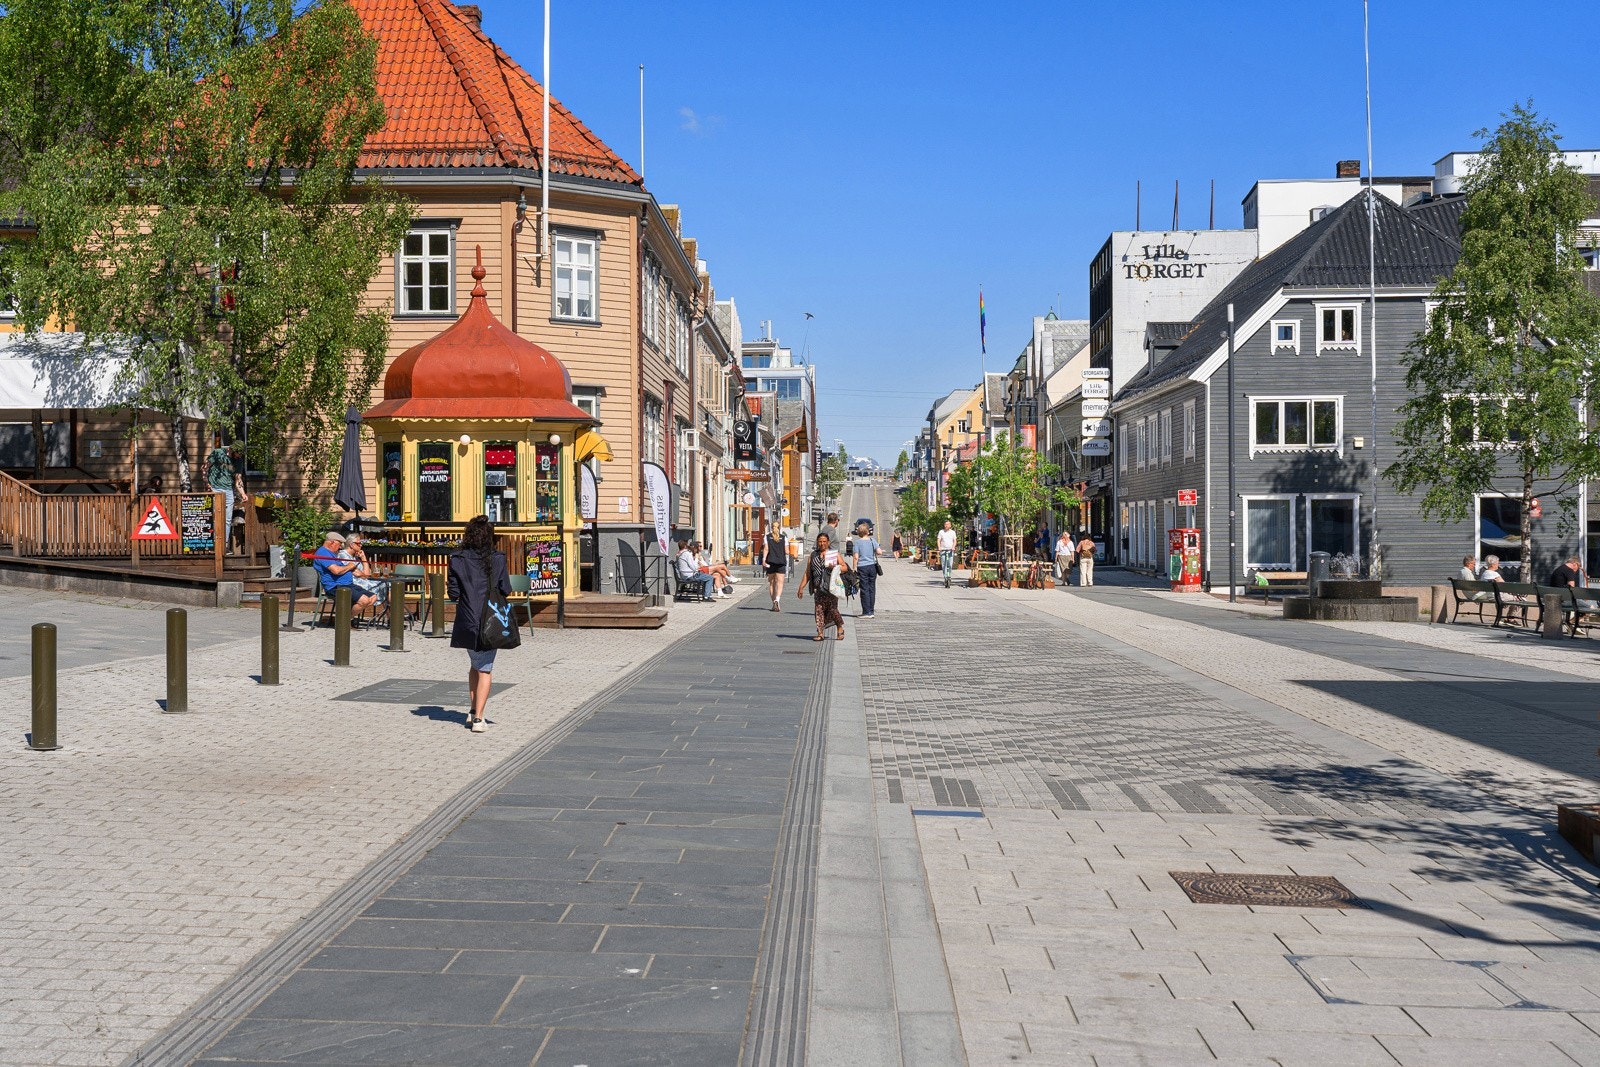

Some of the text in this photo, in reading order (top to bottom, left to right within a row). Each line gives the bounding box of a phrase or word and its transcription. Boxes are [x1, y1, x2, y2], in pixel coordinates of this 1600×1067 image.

[1142, 244, 1185, 260] Lille
[1122, 263, 1207, 280] TORGET
[531, 578, 559, 590] DRINKS
